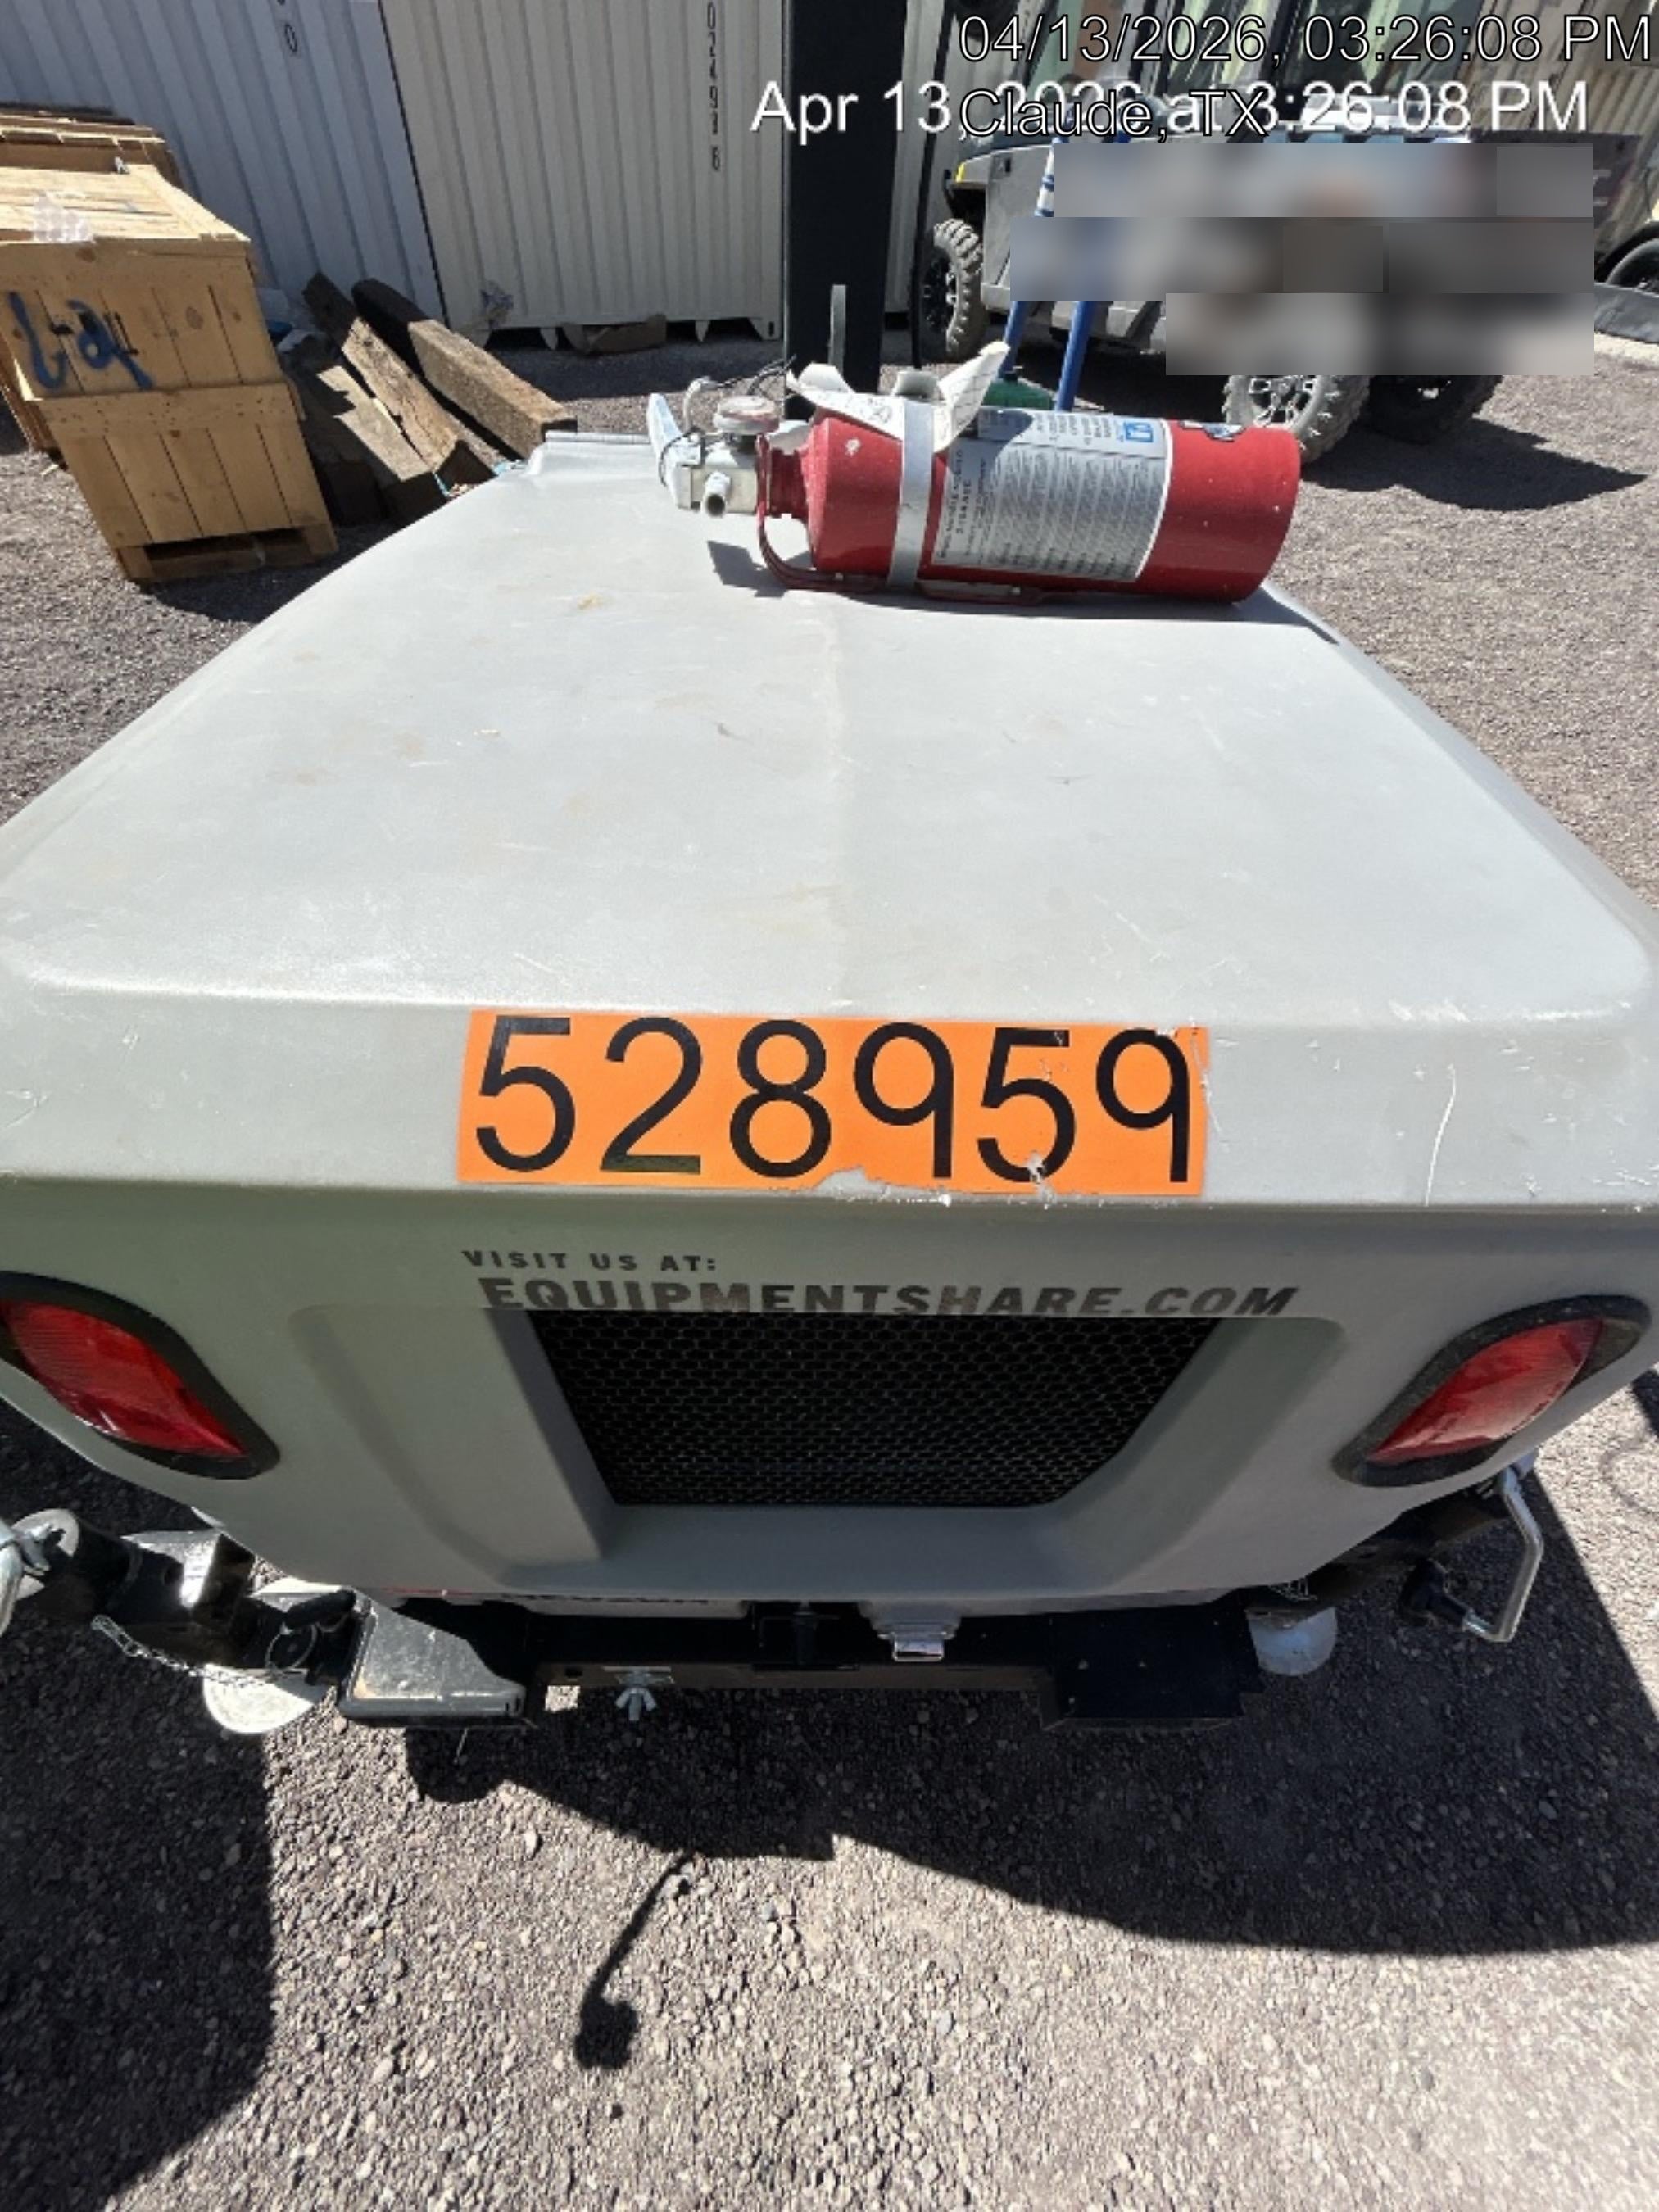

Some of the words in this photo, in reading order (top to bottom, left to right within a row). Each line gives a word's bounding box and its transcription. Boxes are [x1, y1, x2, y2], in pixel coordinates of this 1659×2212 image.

[474, 1016, 1192, 1183] 528959
[460, 1250, 567, 1268] VISIT
[589, 1253, 638, 1271] US
[660, 1255, 715, 1271] AT:
[478, 1276, 1301, 1317] EQUIPMENTSHARE.COM
